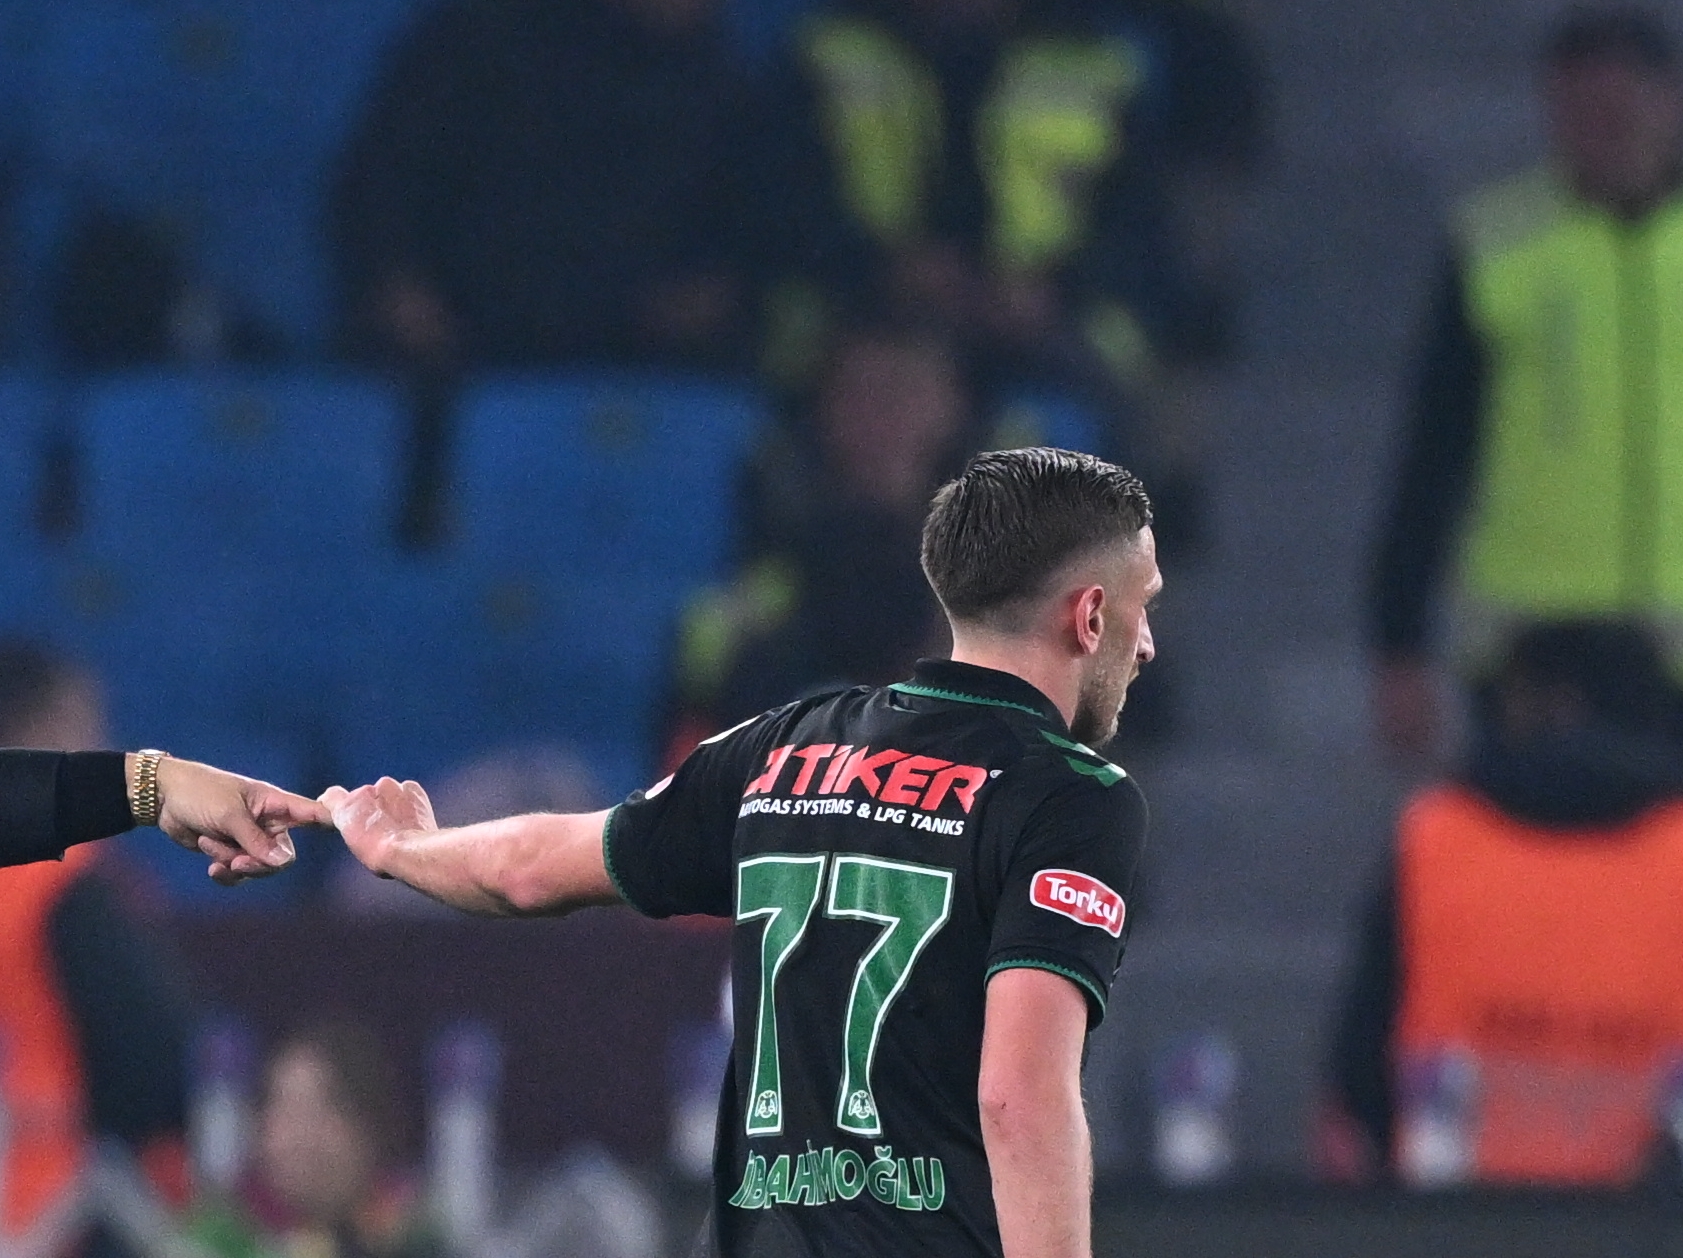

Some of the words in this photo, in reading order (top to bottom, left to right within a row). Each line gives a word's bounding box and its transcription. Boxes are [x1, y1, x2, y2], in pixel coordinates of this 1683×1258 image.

[792, 798, 855, 816] SYSTEMS
[856, 802, 871, 819] &
[874, 806, 905, 824] LPG
[910, 812, 965, 836] TANKS
[735, 851, 956, 1138] 77
